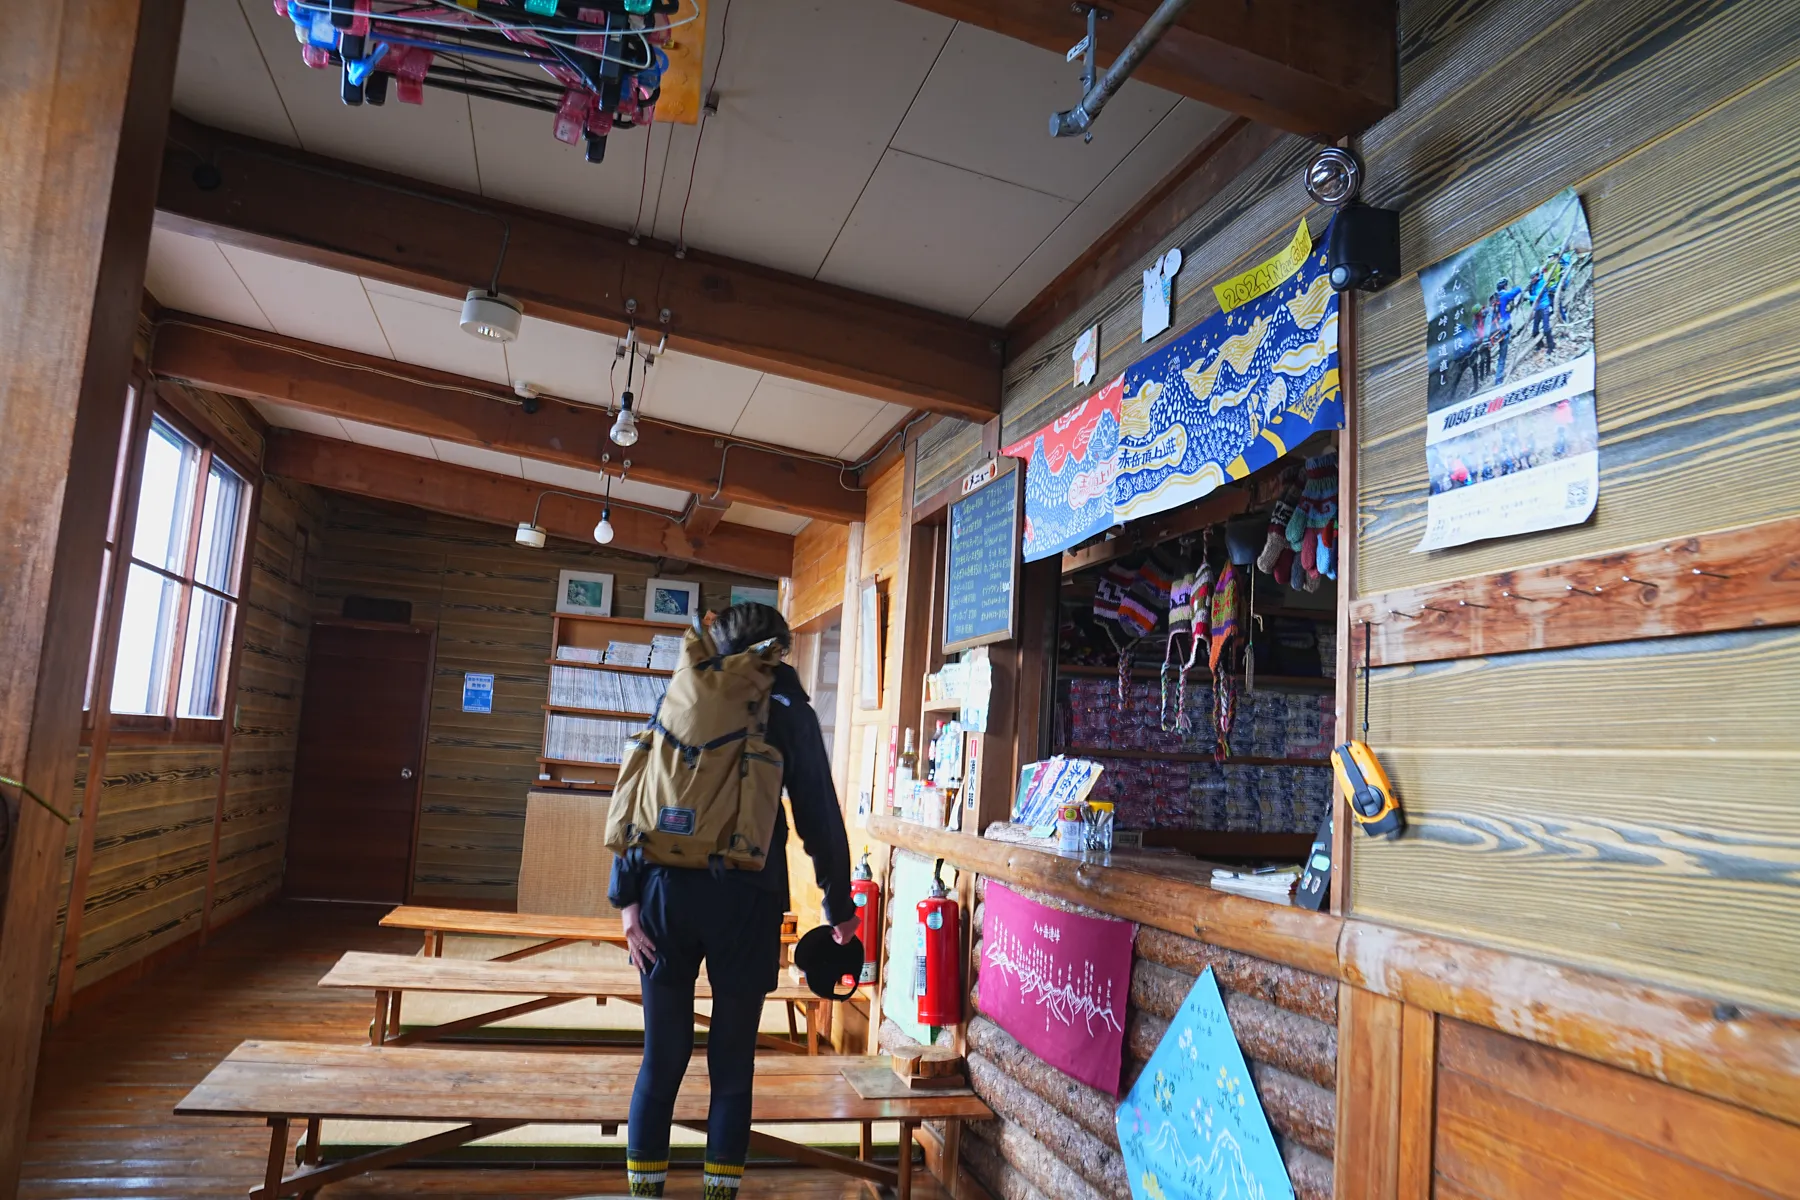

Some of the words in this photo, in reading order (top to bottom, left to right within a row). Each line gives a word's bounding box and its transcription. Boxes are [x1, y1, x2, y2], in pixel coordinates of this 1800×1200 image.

[1451, 264, 1464, 350] みんなが主役
[1442, 406, 1472, 432] 1095
[1118, 436, 1177, 469] 赤岳頂上山荘
[969, 471, 989, 490] メニュー
[967, 759, 976, 808] 消火器
